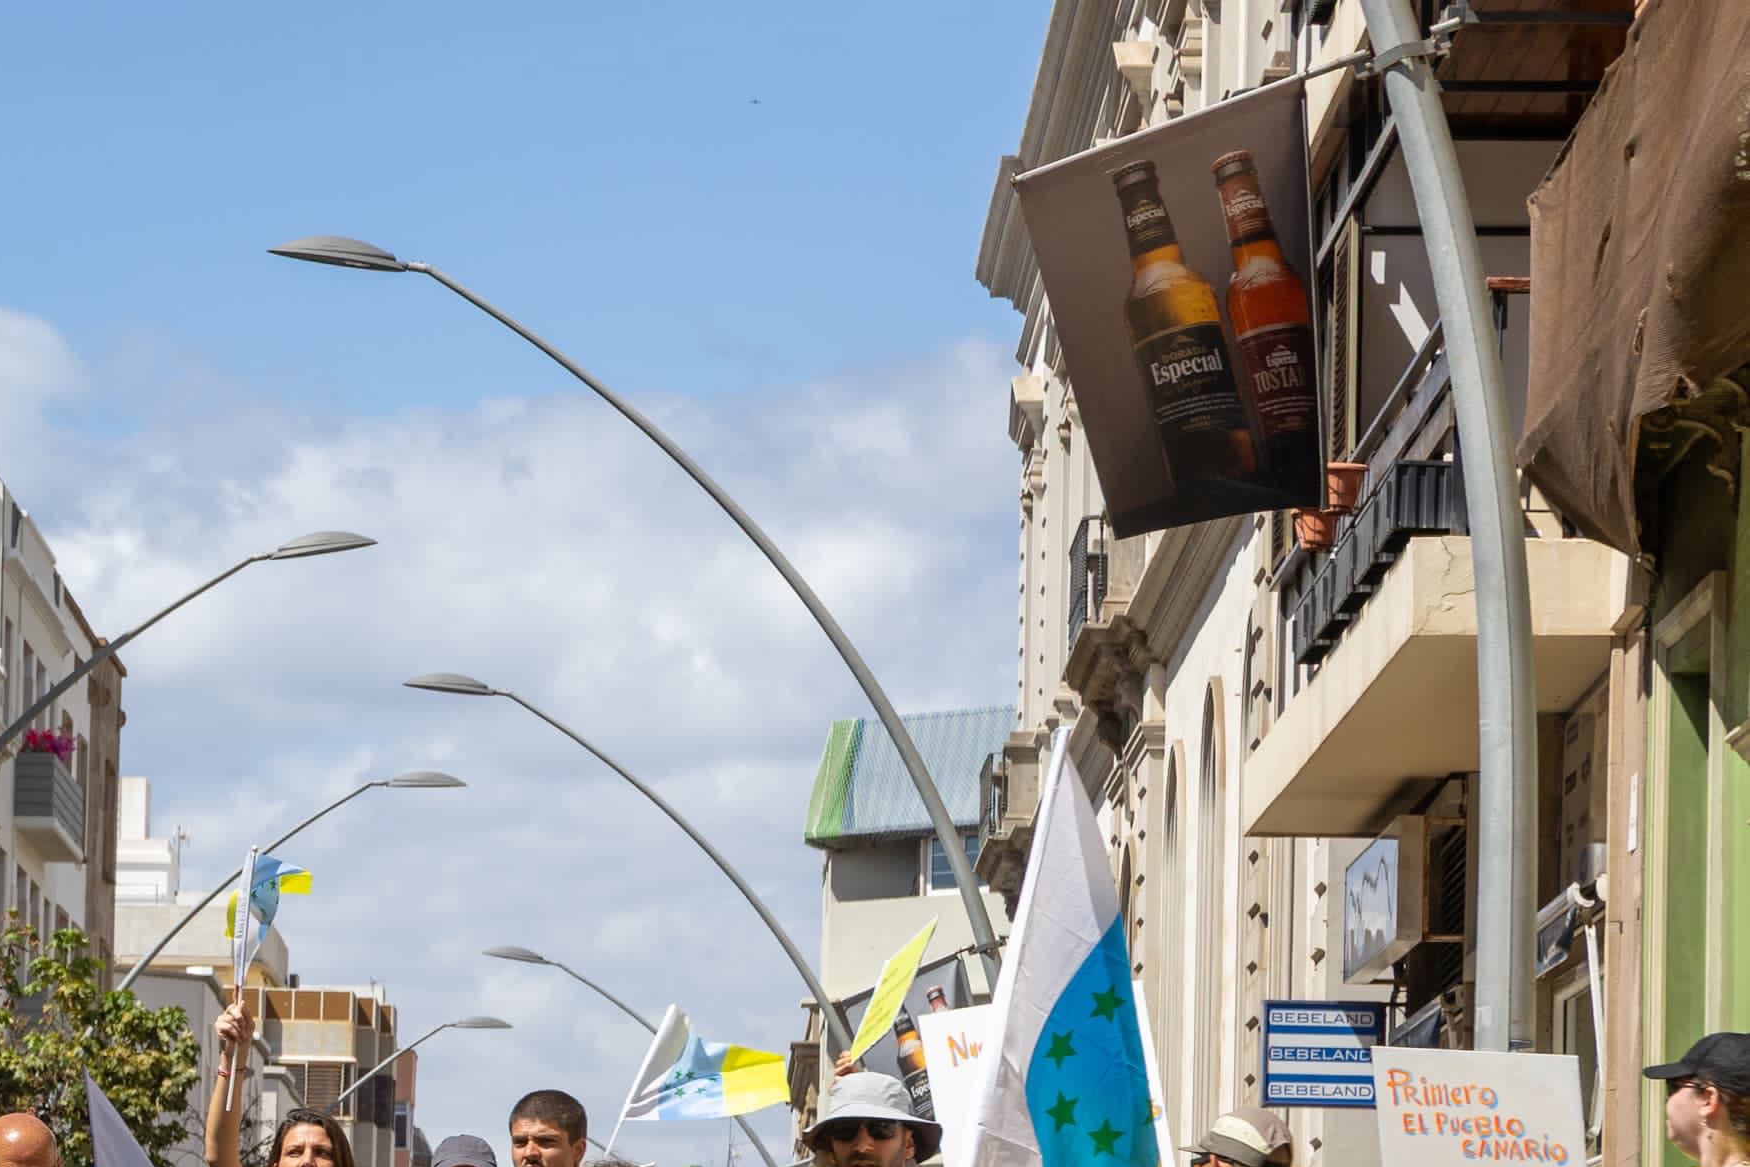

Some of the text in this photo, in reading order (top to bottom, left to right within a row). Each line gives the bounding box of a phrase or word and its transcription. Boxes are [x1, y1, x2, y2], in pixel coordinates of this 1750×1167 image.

[1150, 348, 1224, 387] Especial
[1270, 1011, 1373, 1025] BEBELAND
[1269, 1084, 1372, 1098] BEBELAND
[1402, 1112, 1429, 1136] EL
